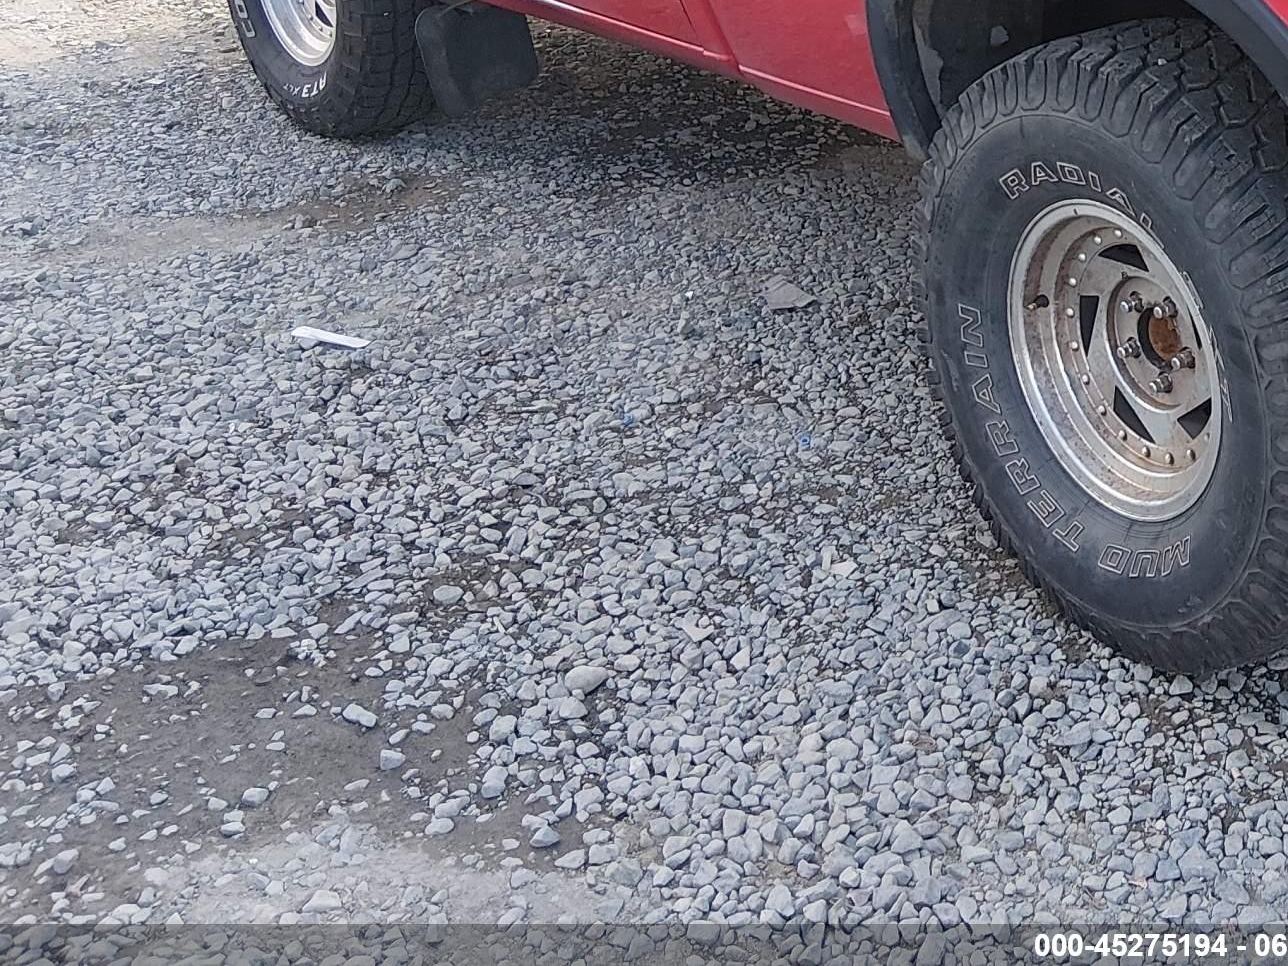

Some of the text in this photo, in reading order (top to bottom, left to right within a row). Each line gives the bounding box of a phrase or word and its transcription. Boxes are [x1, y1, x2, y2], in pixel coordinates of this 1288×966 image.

[301, 71, 327, 98] AT3
[958, 303, 1191, 578] MUD TERRAIN
